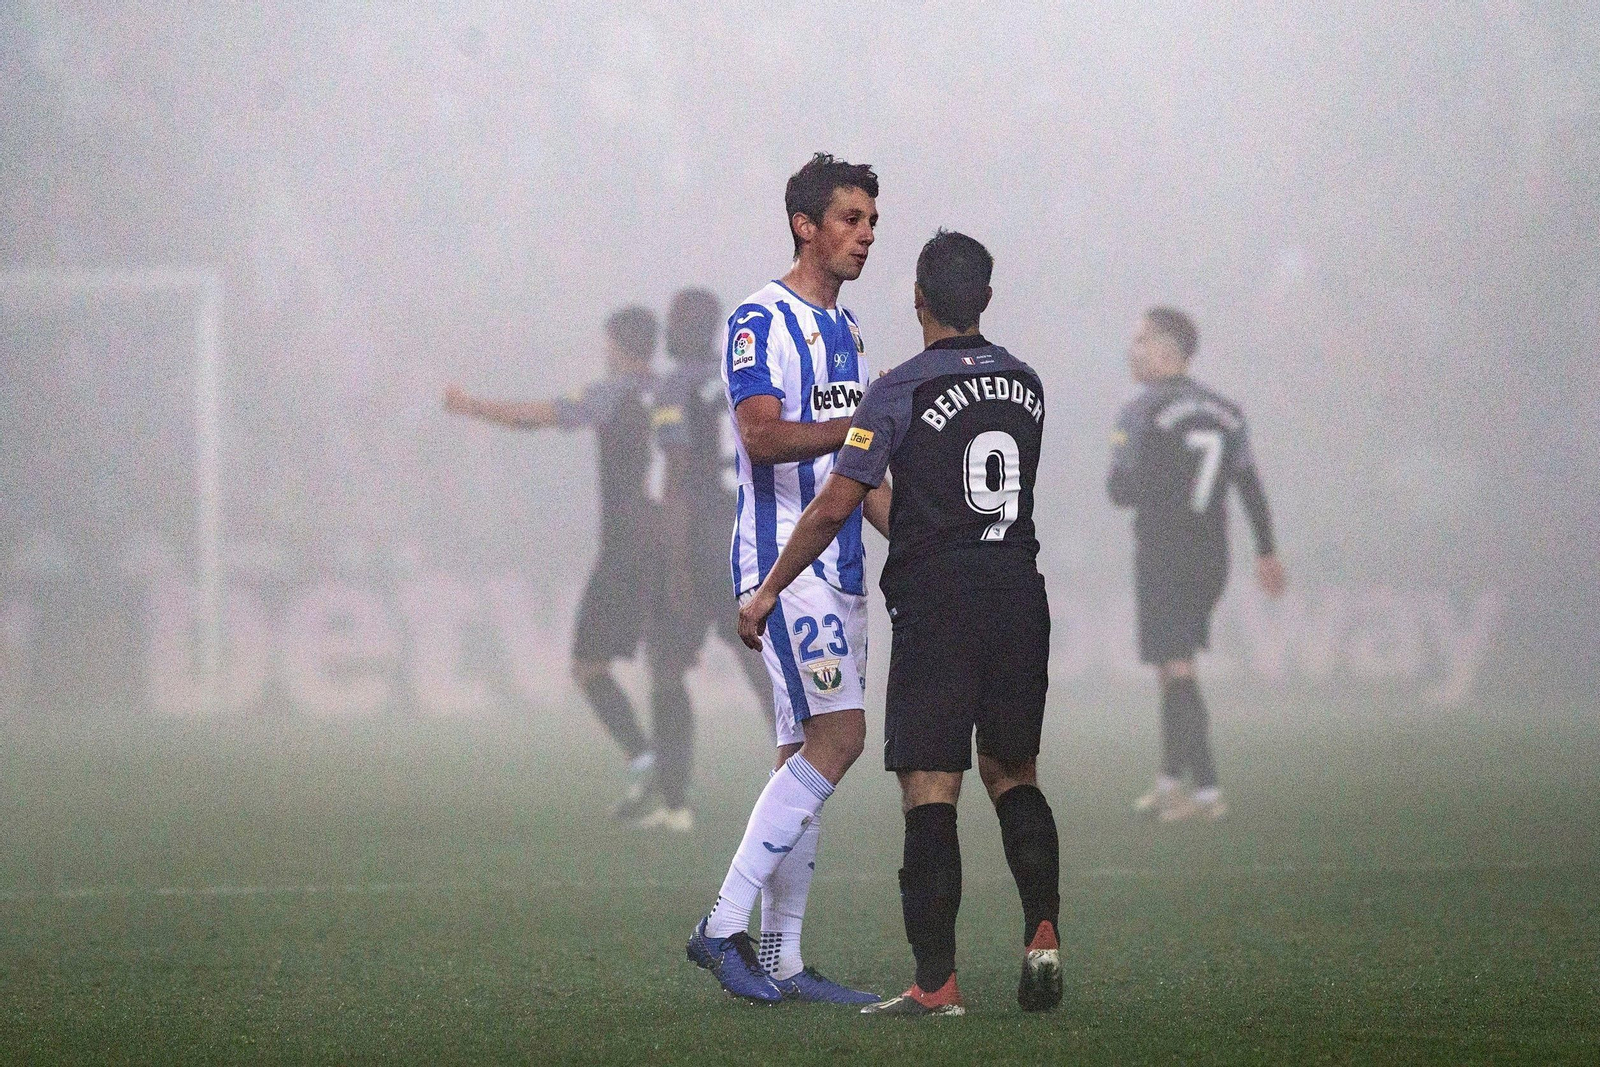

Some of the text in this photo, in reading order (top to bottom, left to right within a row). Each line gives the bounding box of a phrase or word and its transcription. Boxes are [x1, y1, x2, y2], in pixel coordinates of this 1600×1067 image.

[920, 376, 1043, 432] BEN YEDDER
[963, 431, 1020, 541] 9
[1184, 428, 1223, 513] 7
[793, 613, 849, 663] 23
